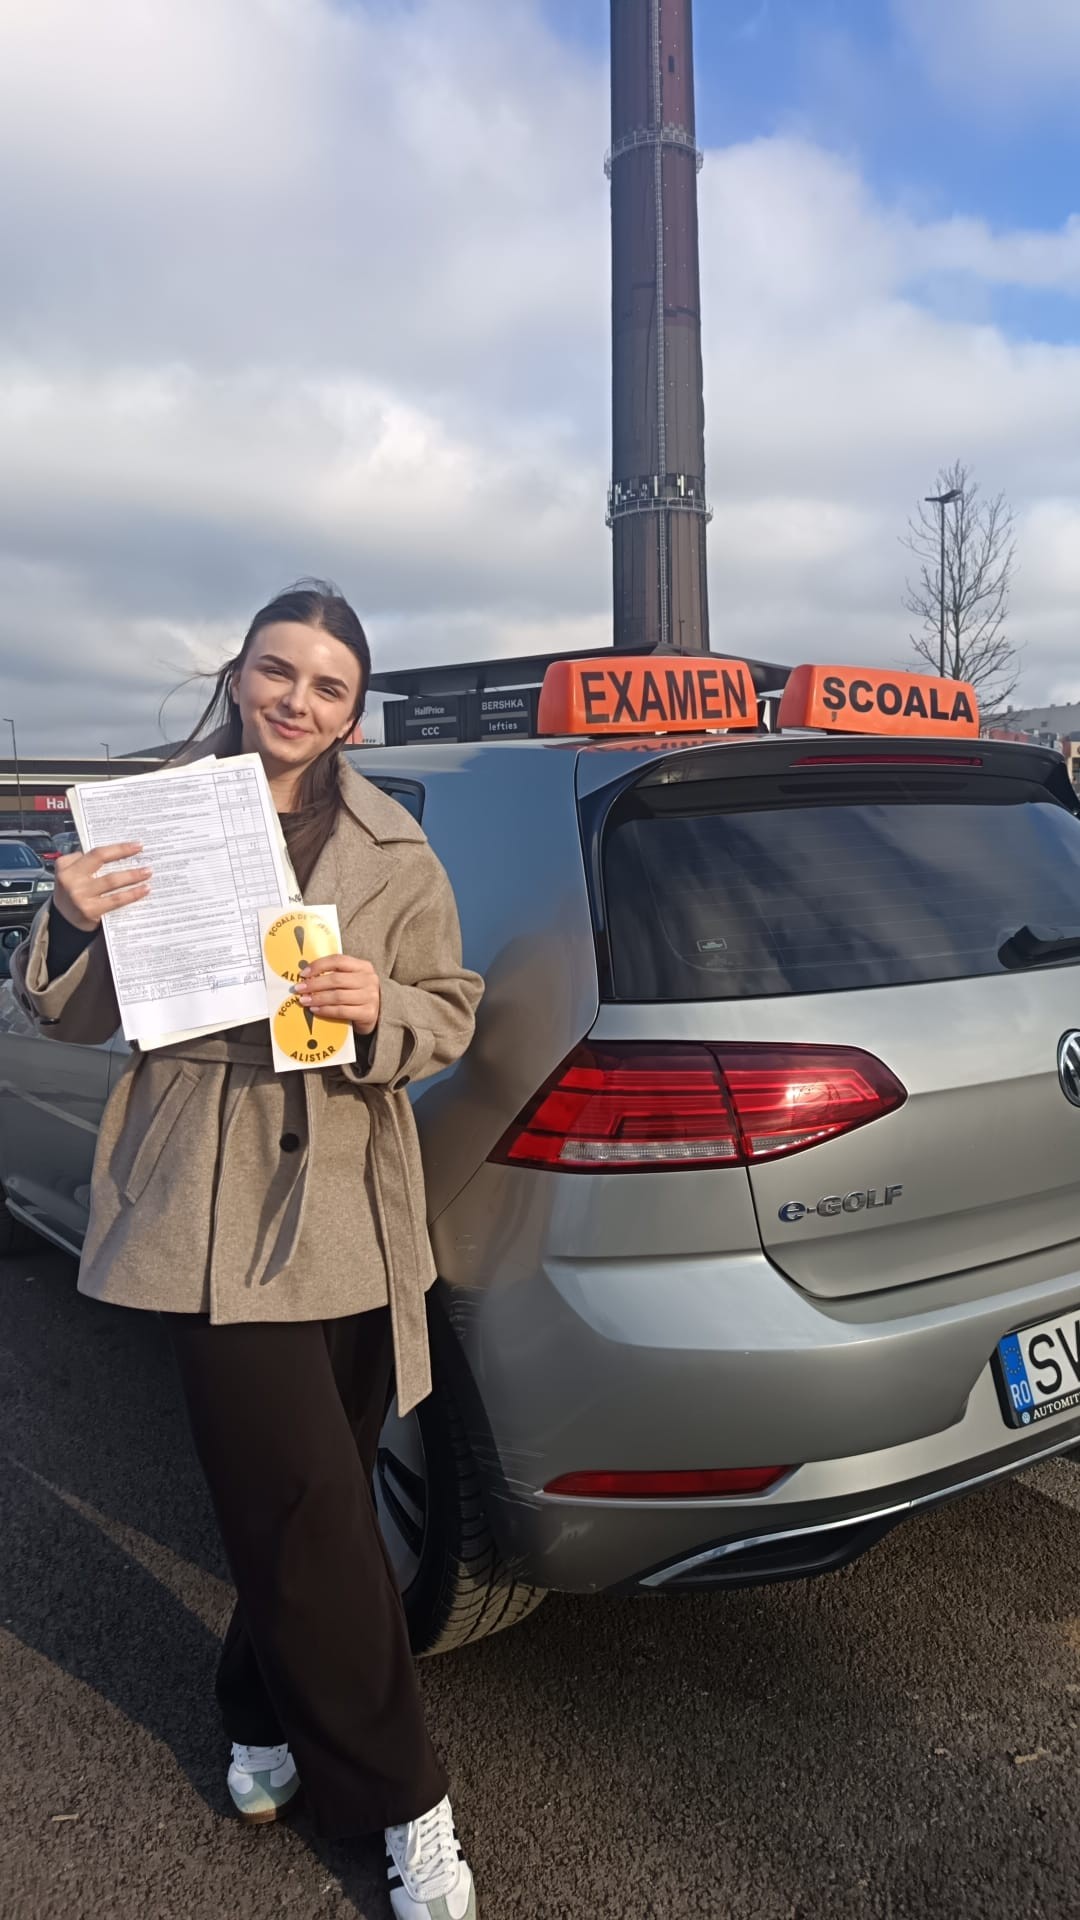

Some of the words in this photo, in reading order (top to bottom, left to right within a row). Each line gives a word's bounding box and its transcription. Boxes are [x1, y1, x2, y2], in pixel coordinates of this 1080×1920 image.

[481, 698, 524, 711] BERSHKA
[580, 669, 747, 724] EXAMEN
[414, 706, 445, 716] HalfPrice
[421, 726, 440, 736] CCC
[488, 720, 518, 731] lefties
[46, 797, 68, 809] Hal
[290, 1045, 337, 1062] ALISTAR
[778, 1184, 903, 1222] e-GOLF
[1028, 1319, 1080, 1395] SV
[1010, 1380, 1031, 1409] RO
[1033, 1391, 1080, 1420] AUTOMIT
